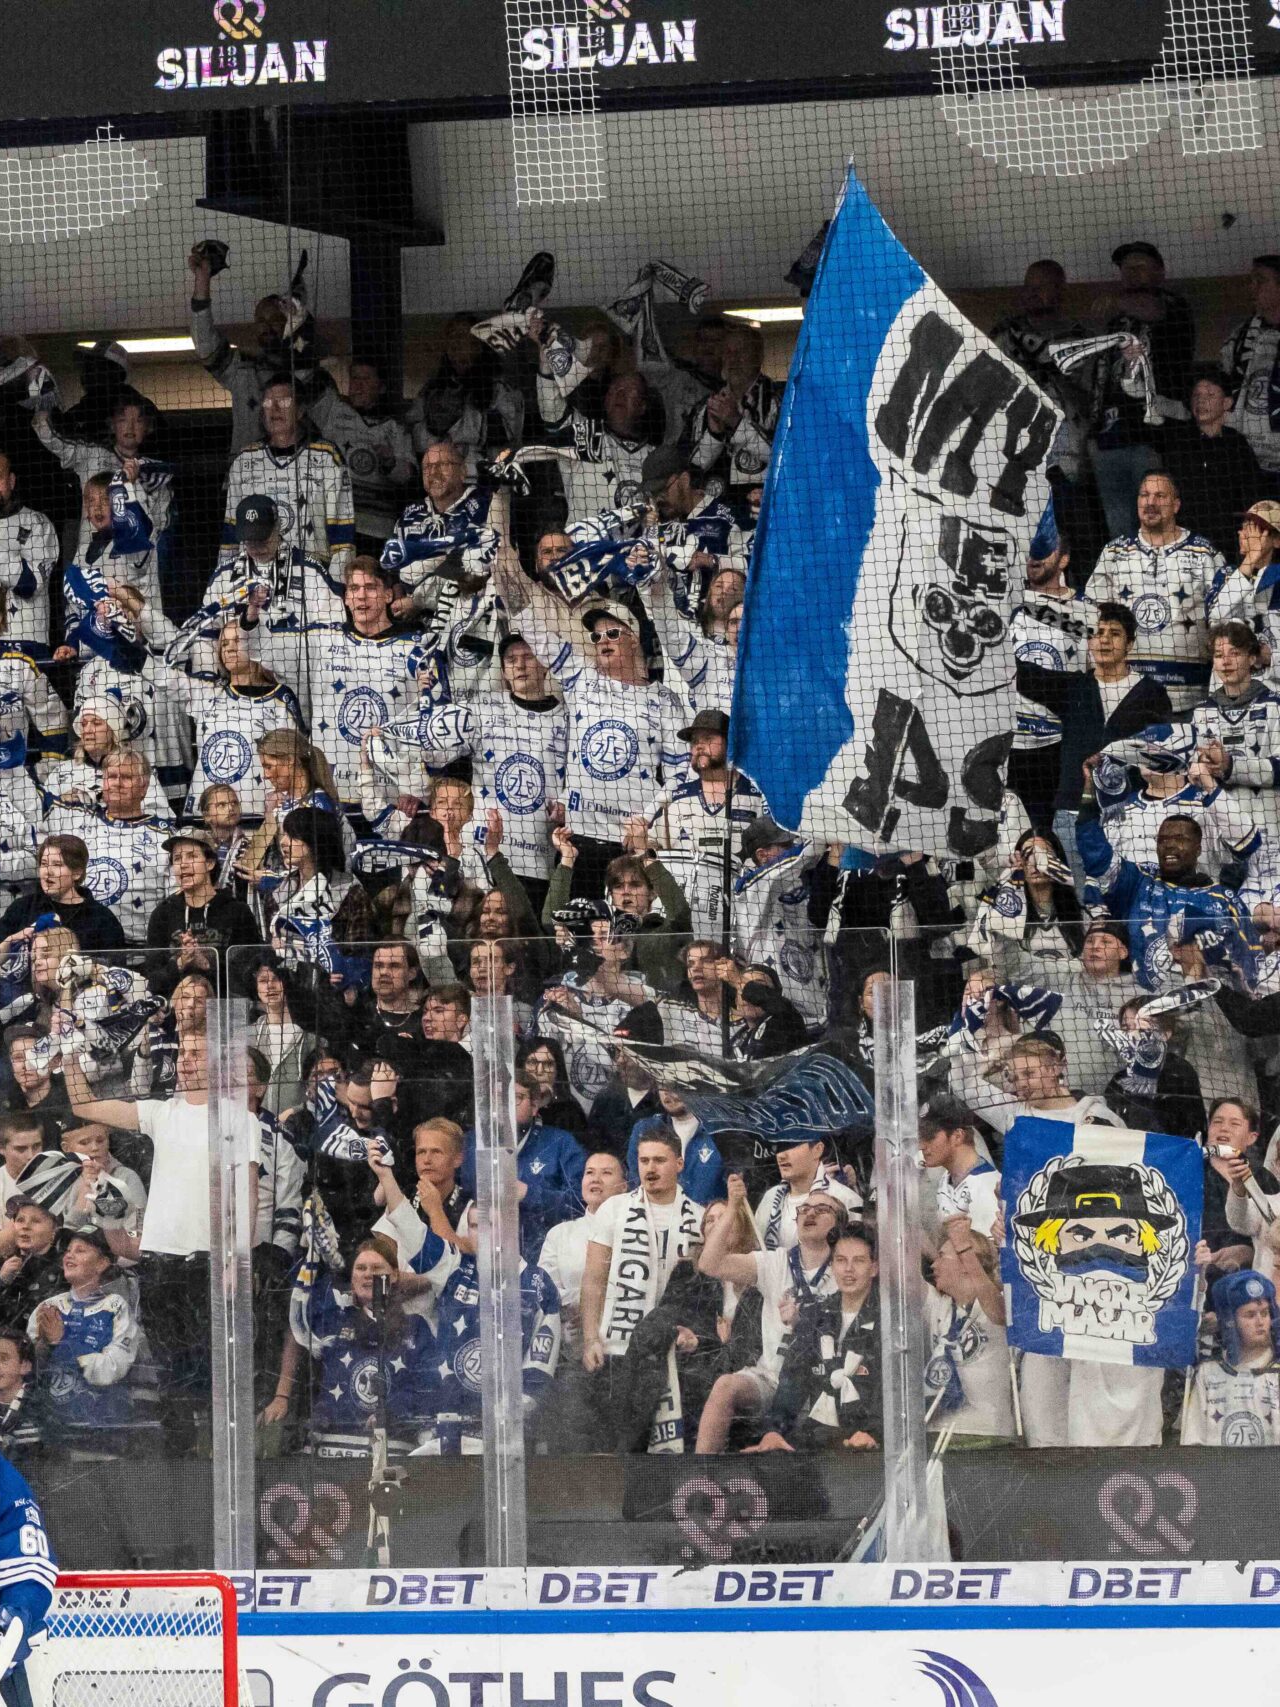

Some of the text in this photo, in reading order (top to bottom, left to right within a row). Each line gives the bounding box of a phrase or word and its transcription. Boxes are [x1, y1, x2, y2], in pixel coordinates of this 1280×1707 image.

[884, 0, 1065, 51] SILJAN
[522, 19, 697, 70] SILJAN
[154, 40, 327, 89] SILJAN
[605, 1206, 649, 1343] KRIGARE
[20, 1524, 50, 1560] 60
[231, 1576, 312, 1606] BET
[366, 1573, 483, 1605] DBET
[539, 1572, 657, 1604] DBET
[713, 1570, 834, 1602] DBET
[889, 1568, 1011, 1600] DBET
[1069, 1567, 1192, 1599] DBET
[312, 1657, 675, 1707] GÖTHES
